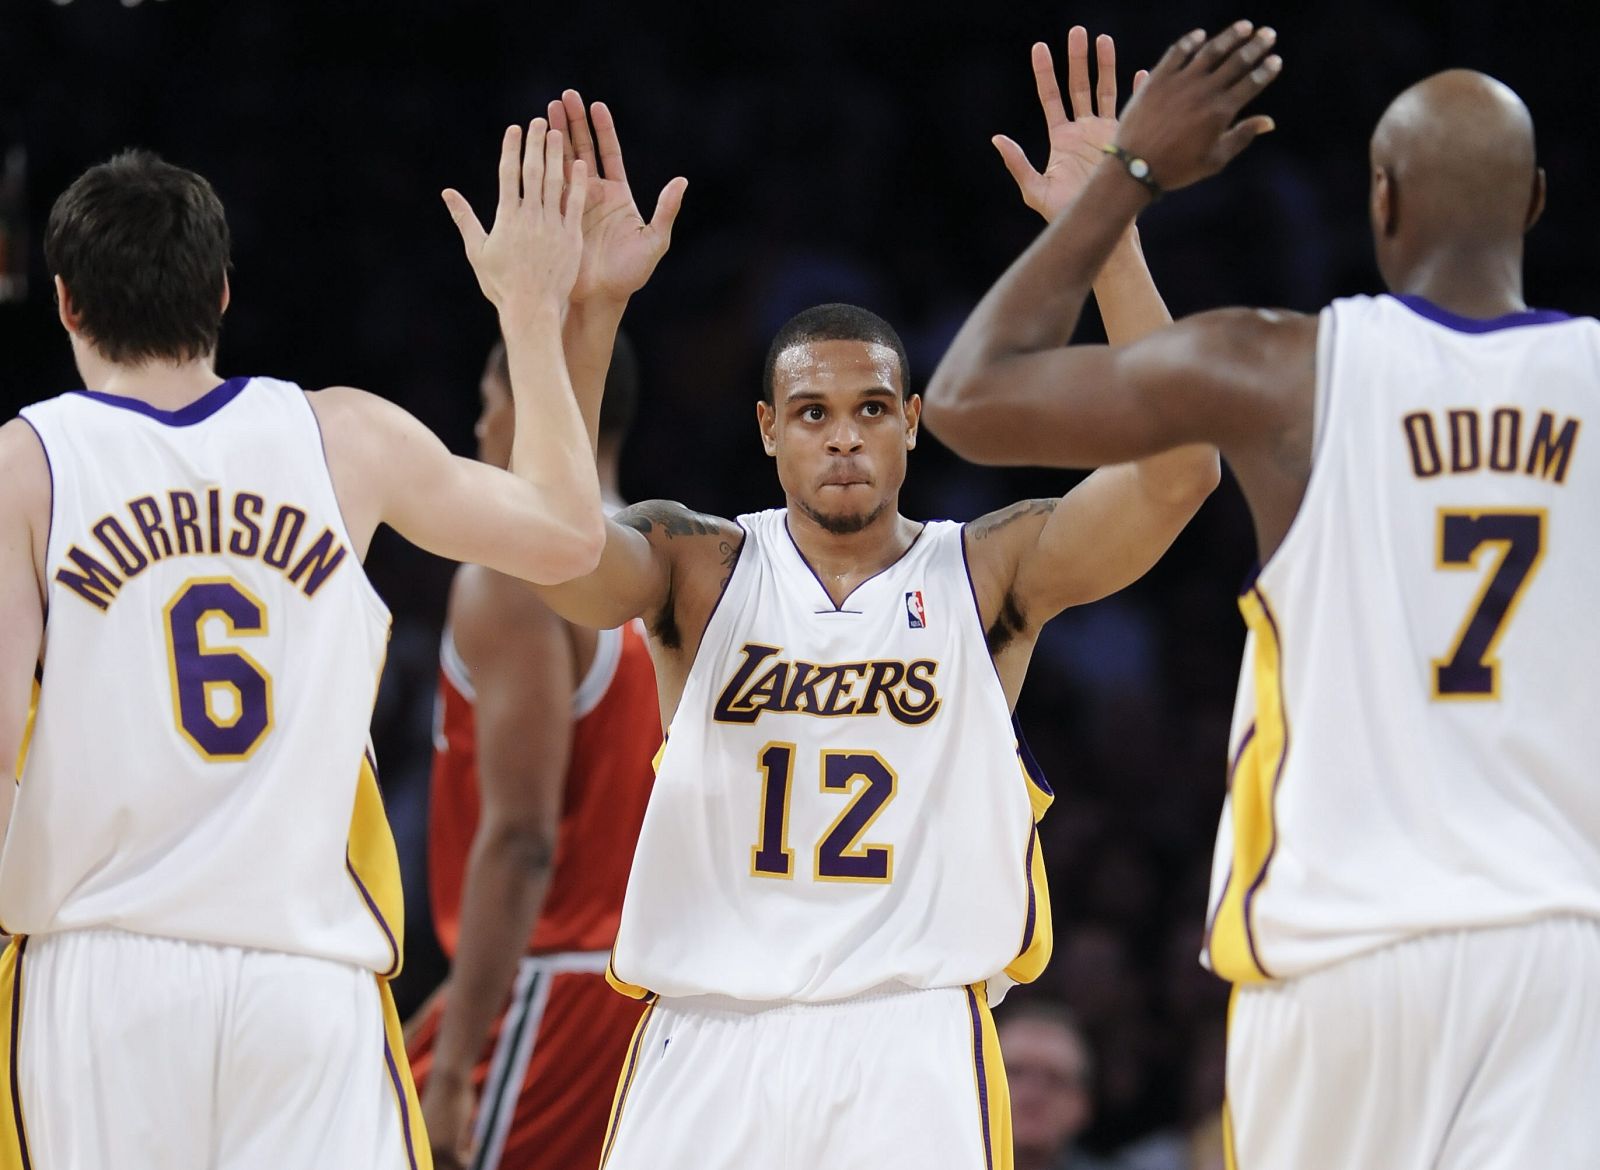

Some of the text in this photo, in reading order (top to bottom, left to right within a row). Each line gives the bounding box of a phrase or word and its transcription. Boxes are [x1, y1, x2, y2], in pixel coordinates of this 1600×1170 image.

[1402, 407, 1581, 485] ODOM
[55, 487, 348, 614] MORRISON
[1430, 507, 1548, 703] 7
[162, 576, 275, 763] 6
[713, 642, 942, 727] LAKERS
[749, 740, 898, 884] 12
